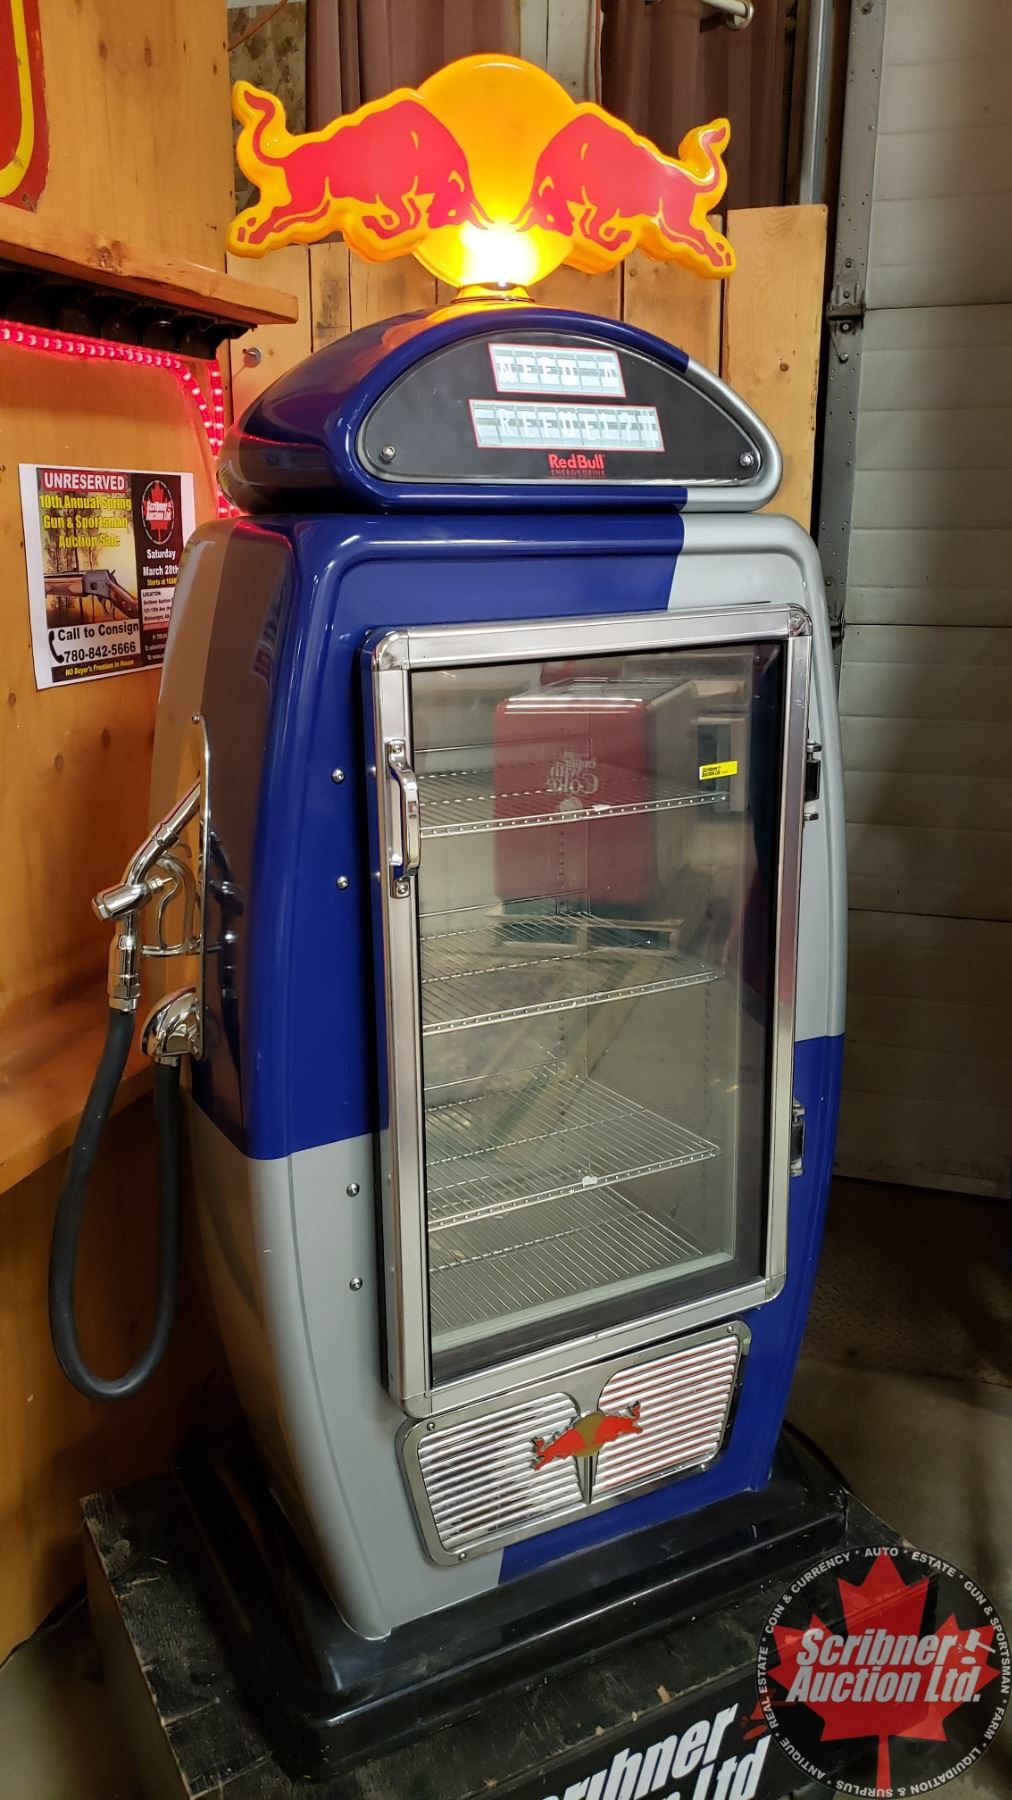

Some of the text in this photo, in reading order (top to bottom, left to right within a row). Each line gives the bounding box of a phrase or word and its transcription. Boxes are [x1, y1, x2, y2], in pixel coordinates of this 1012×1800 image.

[44, 472, 125, 490] UNRESERVED
[40, 494, 62, 509] 10th
[63, 494, 100, 509] Annual
[43, 514, 128, 529] Gun & Sportsman
[59, 534, 120, 548] Auction Sale
[146, 548, 176, 561] Saturday
[143, 566, 164, 576] March
[58, 622, 138, 641] Call to Consign
[64, 641, 136, 663] 780-842-5666
